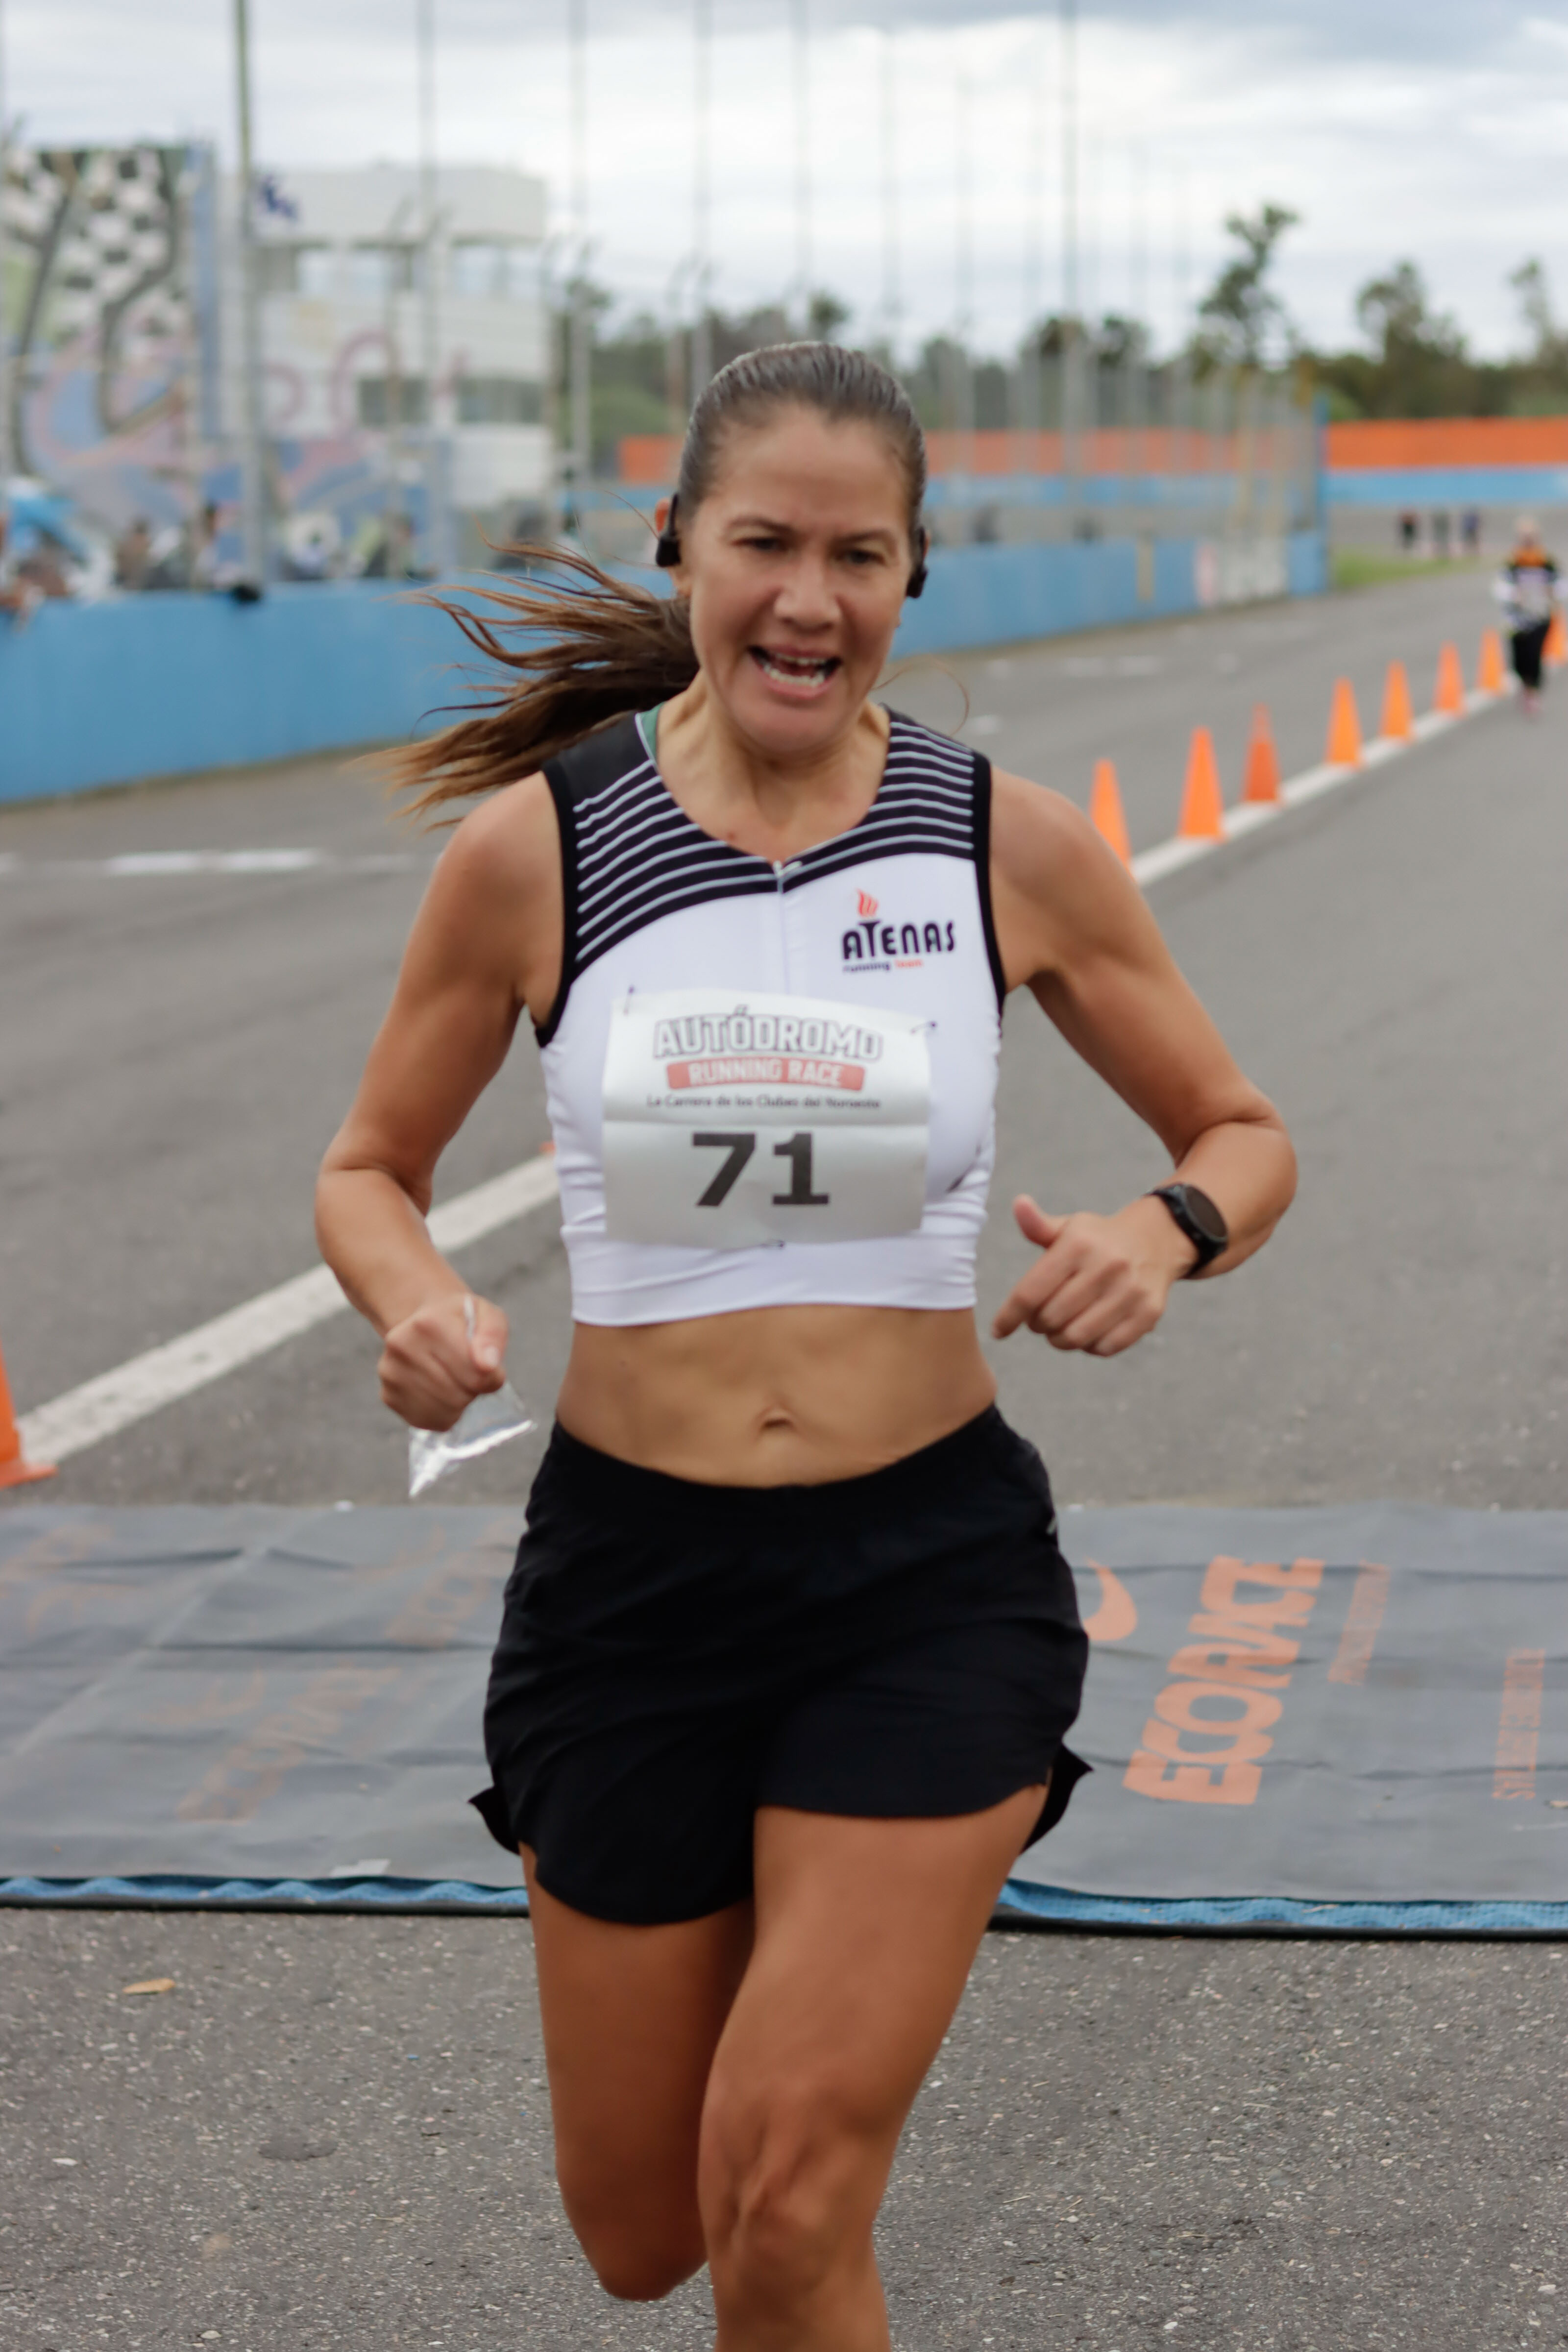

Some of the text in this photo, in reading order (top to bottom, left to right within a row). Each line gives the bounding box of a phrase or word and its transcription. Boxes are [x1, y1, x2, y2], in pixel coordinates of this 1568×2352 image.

[841, 918, 955, 960] ATENAS
[654, 1004, 883, 1062] AUTÓDROMO
[688, 1059, 844, 1087] RUNNING RACE
[647, 1093, 662, 1107] La
[716, 1093, 731, 1107] de
[692, 1132, 829, 1207] 71
